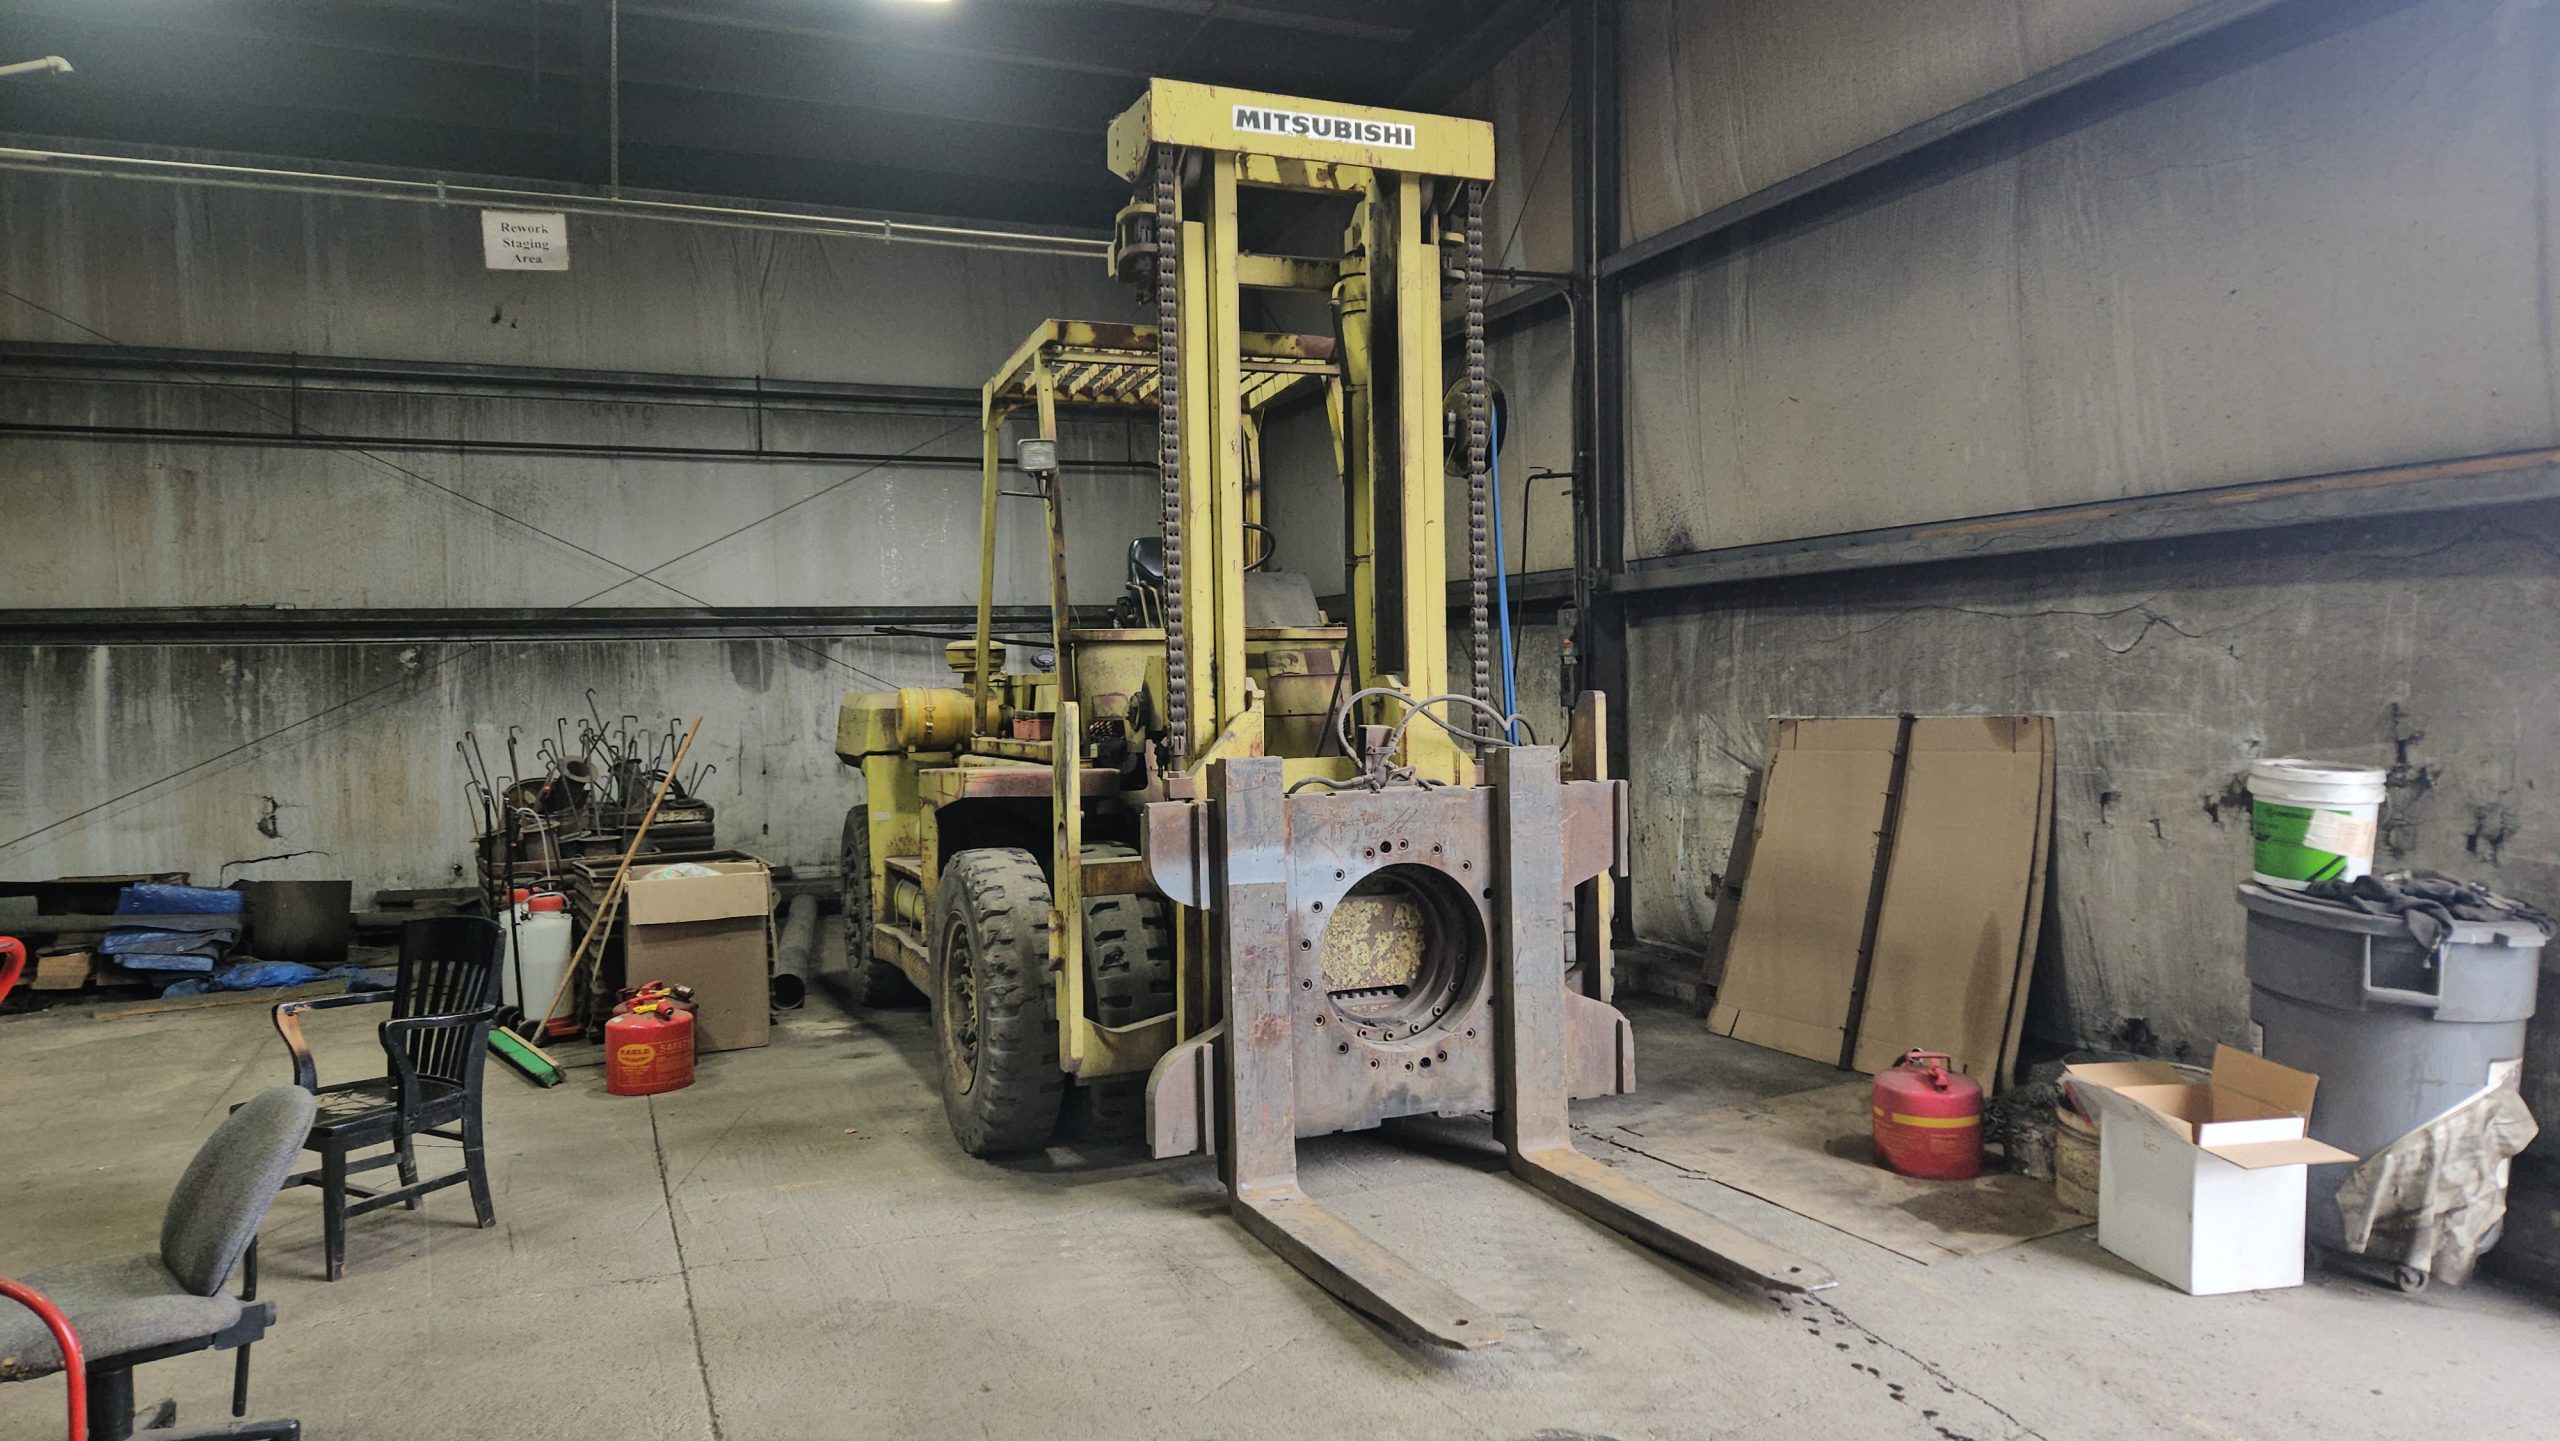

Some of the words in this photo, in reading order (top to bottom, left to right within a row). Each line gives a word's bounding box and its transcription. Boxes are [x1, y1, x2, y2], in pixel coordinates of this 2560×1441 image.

[1236, 109, 1413, 146] MITSUBISHI
[501, 222, 549, 234] Rework
[502, 238, 550, 251] Staging
[514, 254, 543, 264] Area
